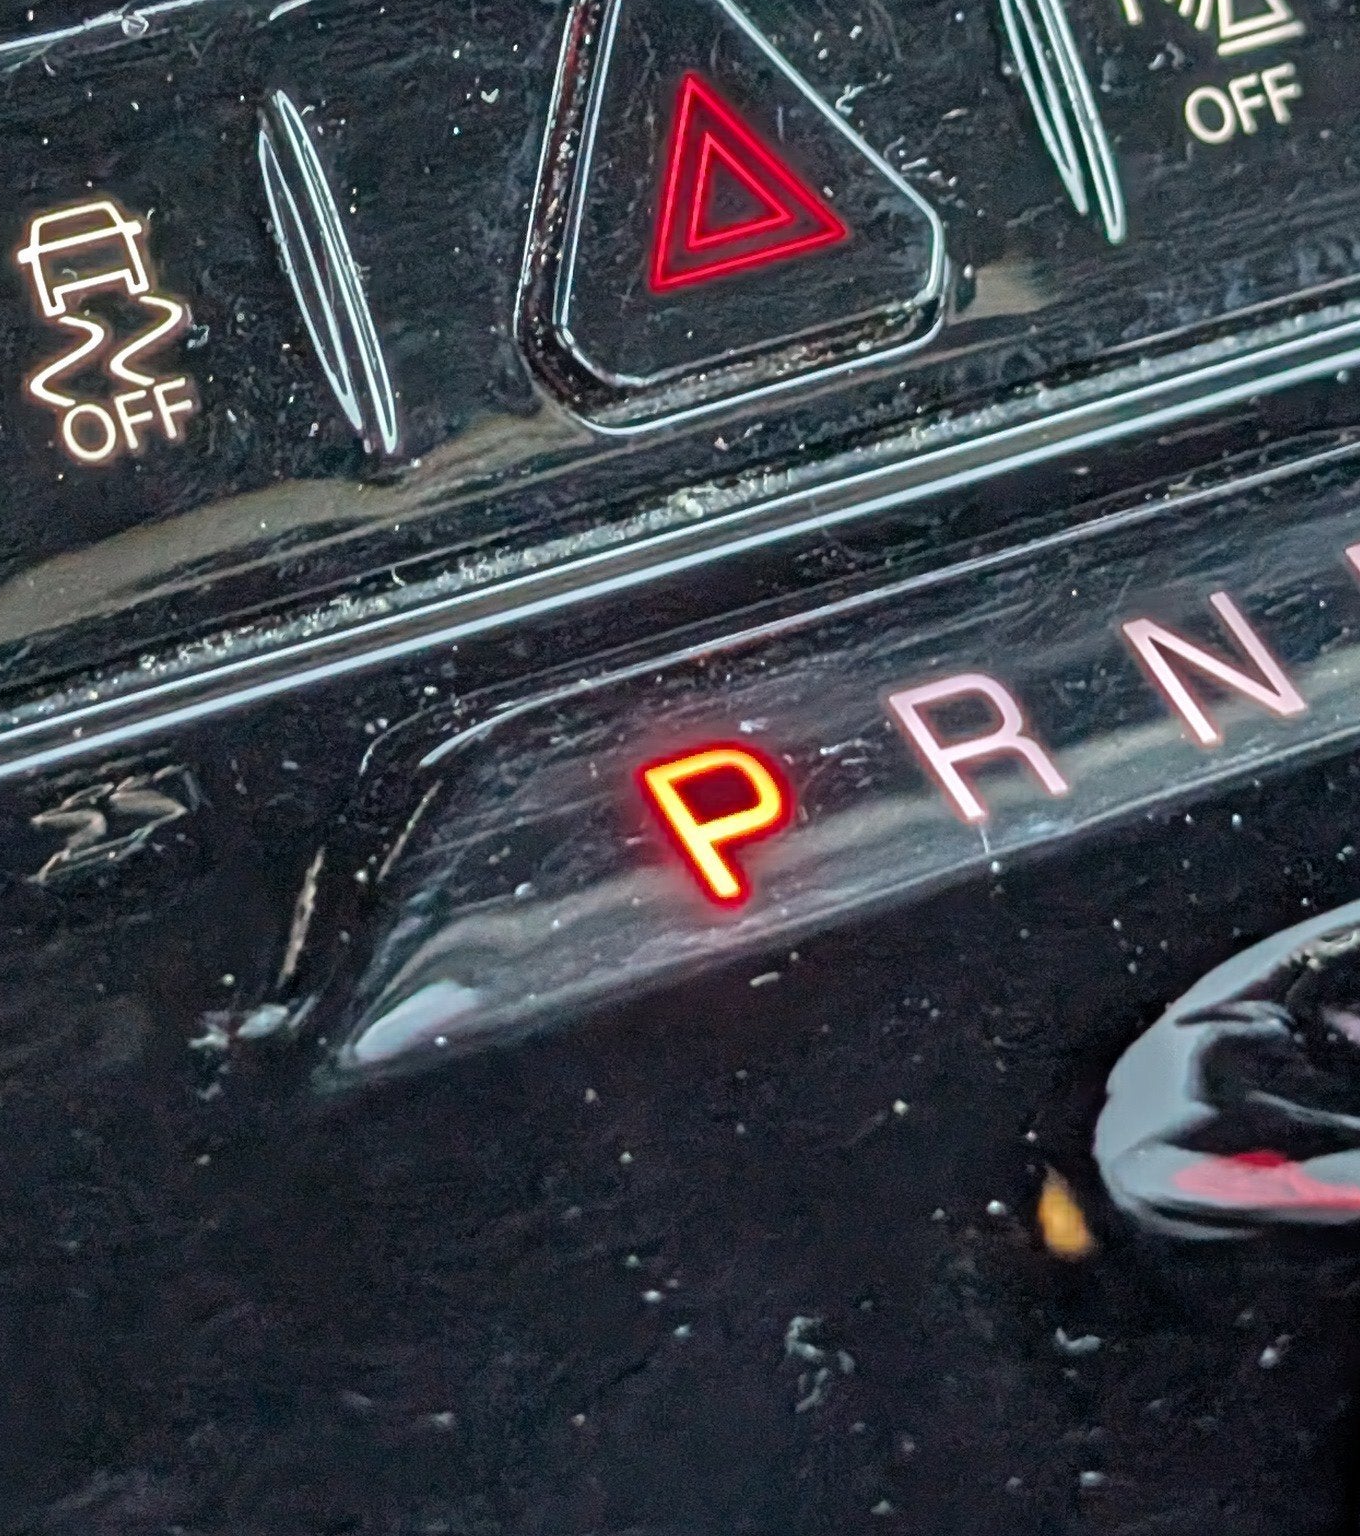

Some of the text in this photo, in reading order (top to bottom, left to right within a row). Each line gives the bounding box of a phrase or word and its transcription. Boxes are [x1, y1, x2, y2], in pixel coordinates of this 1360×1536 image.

[1184, 64, 1302, 145] OFF
[63, 378, 192, 462] OFF
[643, 748, 788, 900] P
[889, 673, 1068, 823] R
[1122, 591, 1306, 747] N
